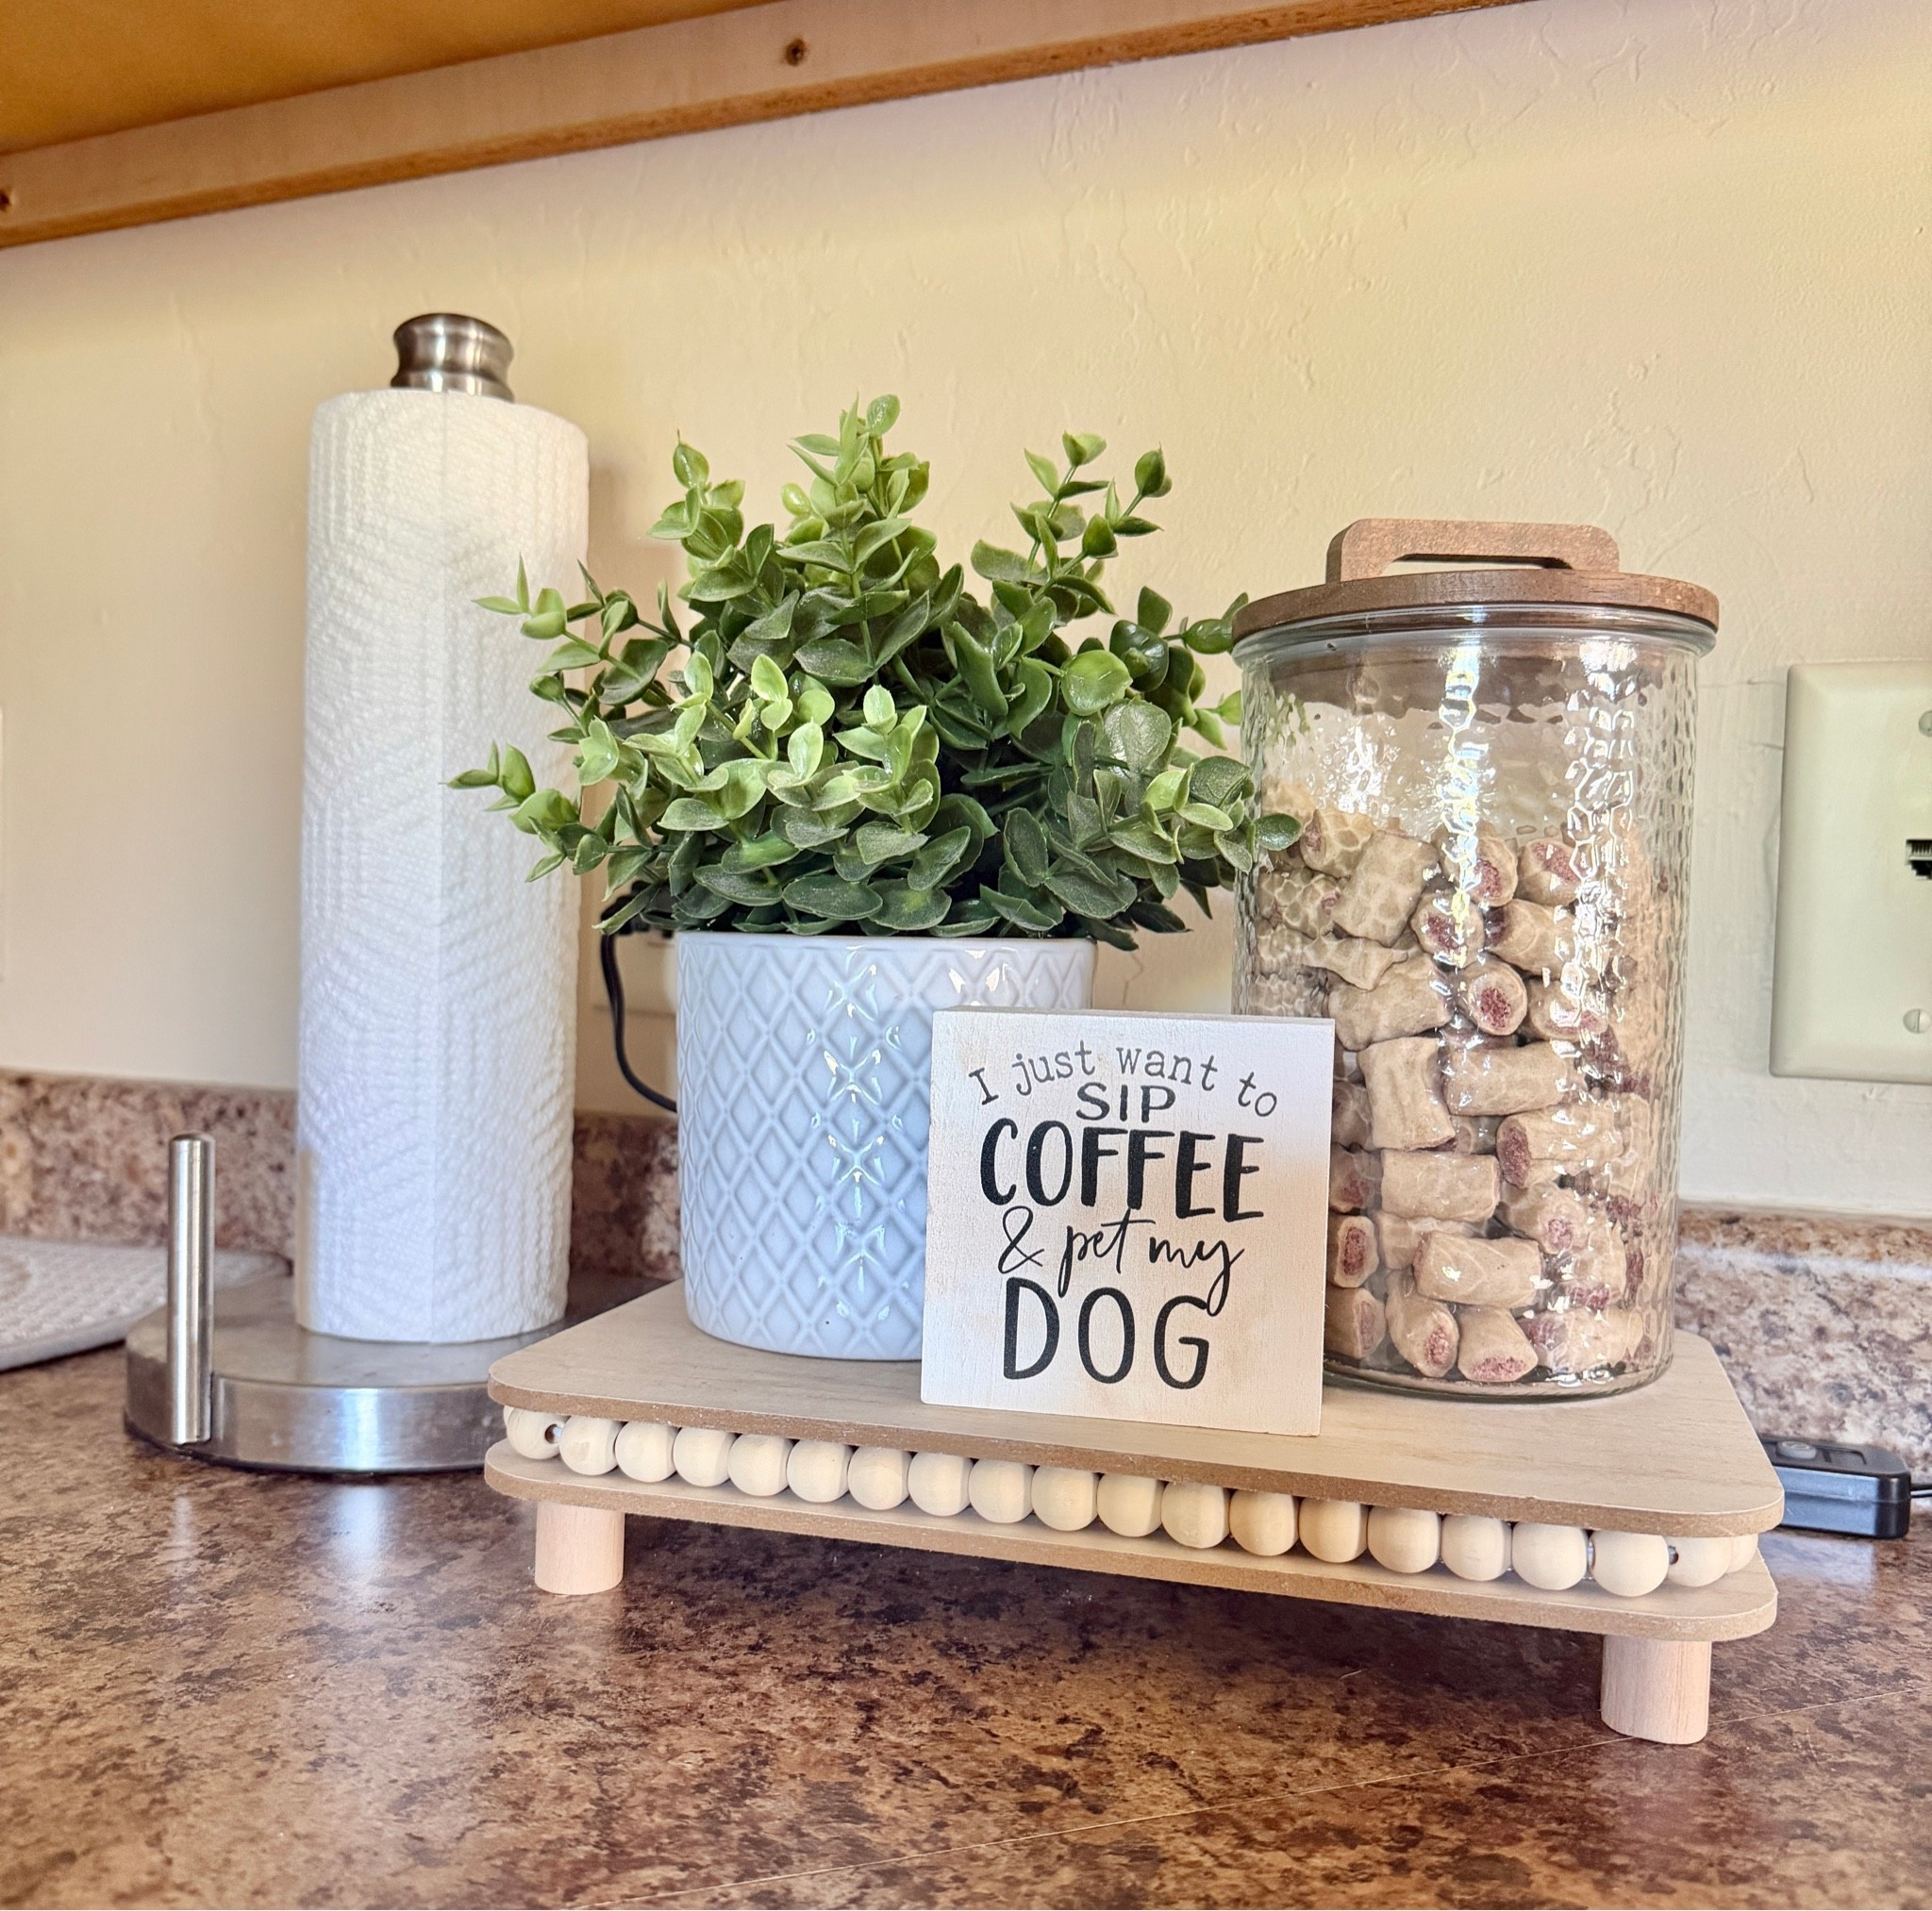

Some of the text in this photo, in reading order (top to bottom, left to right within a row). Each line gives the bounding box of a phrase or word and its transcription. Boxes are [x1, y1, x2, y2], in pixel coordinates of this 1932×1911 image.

[968, 1039, 1277, 1117] I just want to
[1075, 1082, 1176, 1122] SIP
[979, 1118, 1264, 1223] COFFEE
[997, 1205, 1245, 1317] & pet my
[1003, 1276, 1210, 1389] DOG
